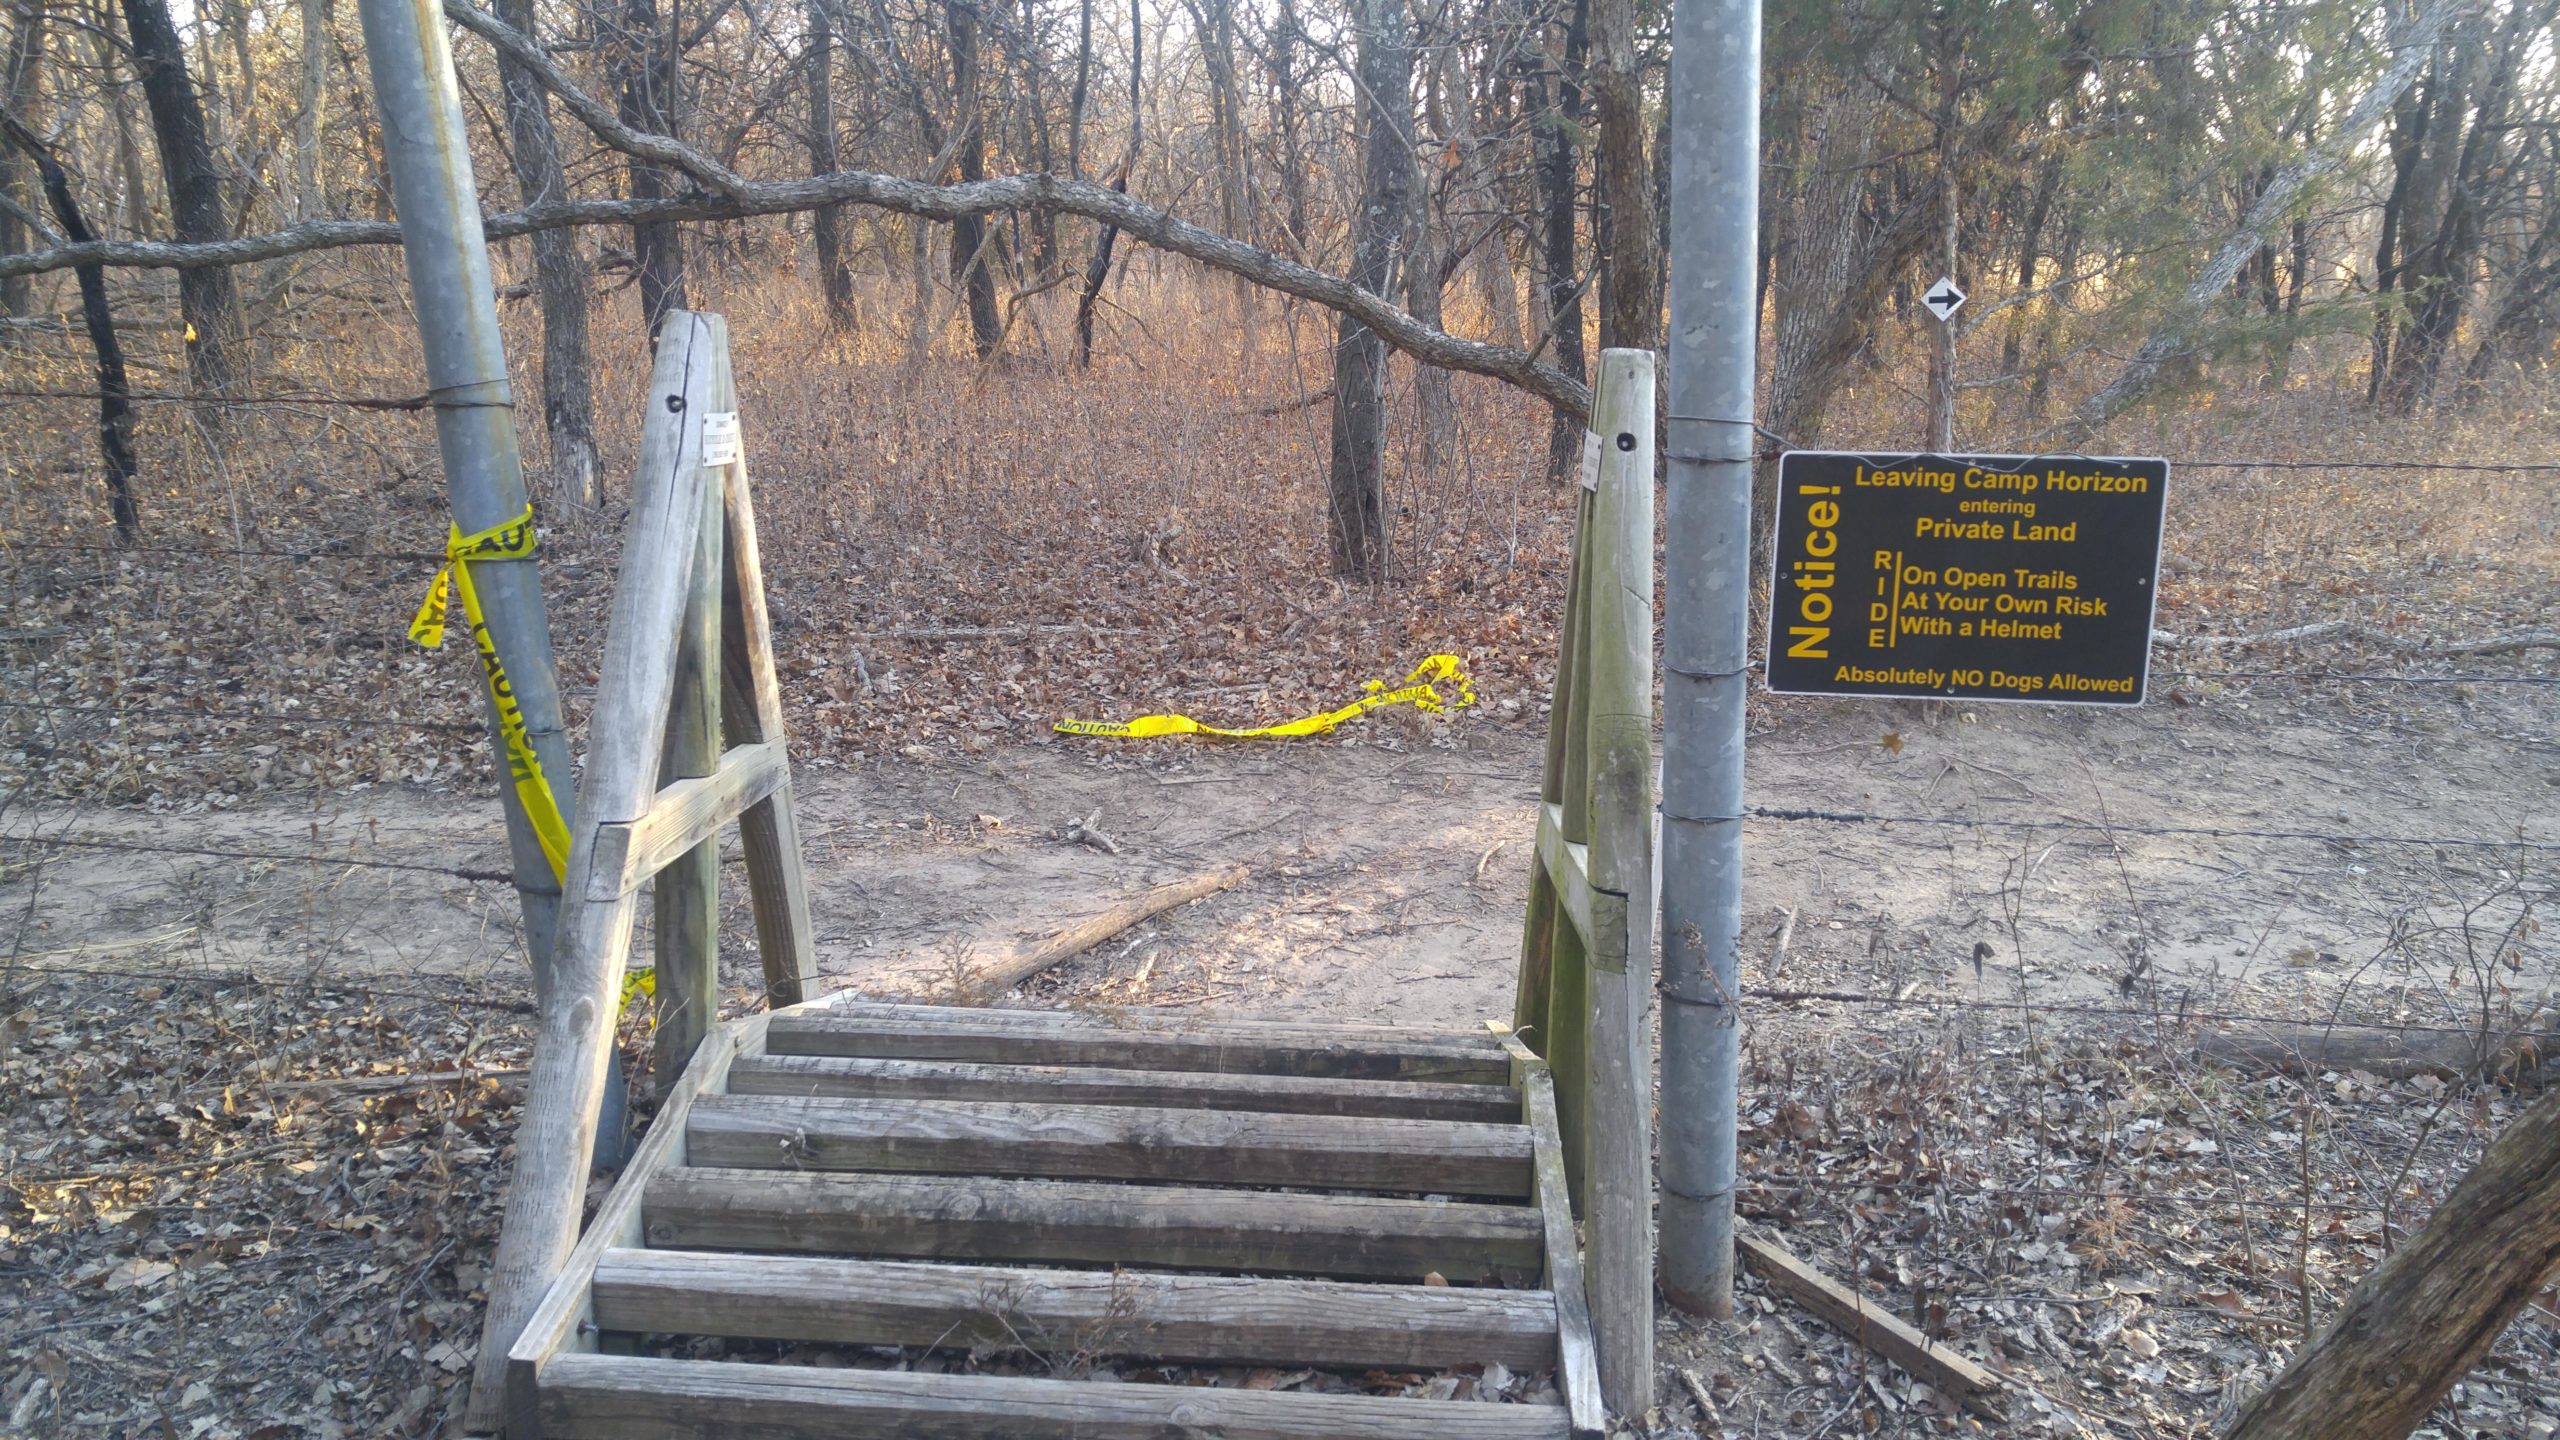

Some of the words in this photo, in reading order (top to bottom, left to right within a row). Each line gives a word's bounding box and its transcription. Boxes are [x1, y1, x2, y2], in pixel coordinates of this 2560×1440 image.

[1856, 466, 1956, 493] Leaving
[1964, 469, 2038, 494] Camp
[2047, 470, 2147, 493] Horizon
[1959, 499, 2036, 517] entering
[1916, 517, 2005, 540] Private
[2012, 520, 2077, 542] Land
[1787, 485, 1840, 659] Notice!
[1903, 566, 1937, 585] On
[1943, 567, 2006, 590] Open
[2015, 568, 2077, 590] Trails
[1901, 591, 1928, 610] At
[1935, 592, 1989, 612] Your
[1995, 593, 2048, 613] Own
[2055, 596, 2106, 616] Risk
[1900, 616, 1952, 635] With
[1959, 621, 1973, 637] a
[1980, 619, 2062, 640] Helmet
[1835, 665, 1945, 688] Absolutely
[1951, 670, 1984, 687] NO
[1990, 671, 2043, 692] Dogs
[2048, 674, 2133, 692] Allowed
[473, 622, 546, 779] CAUTIO
